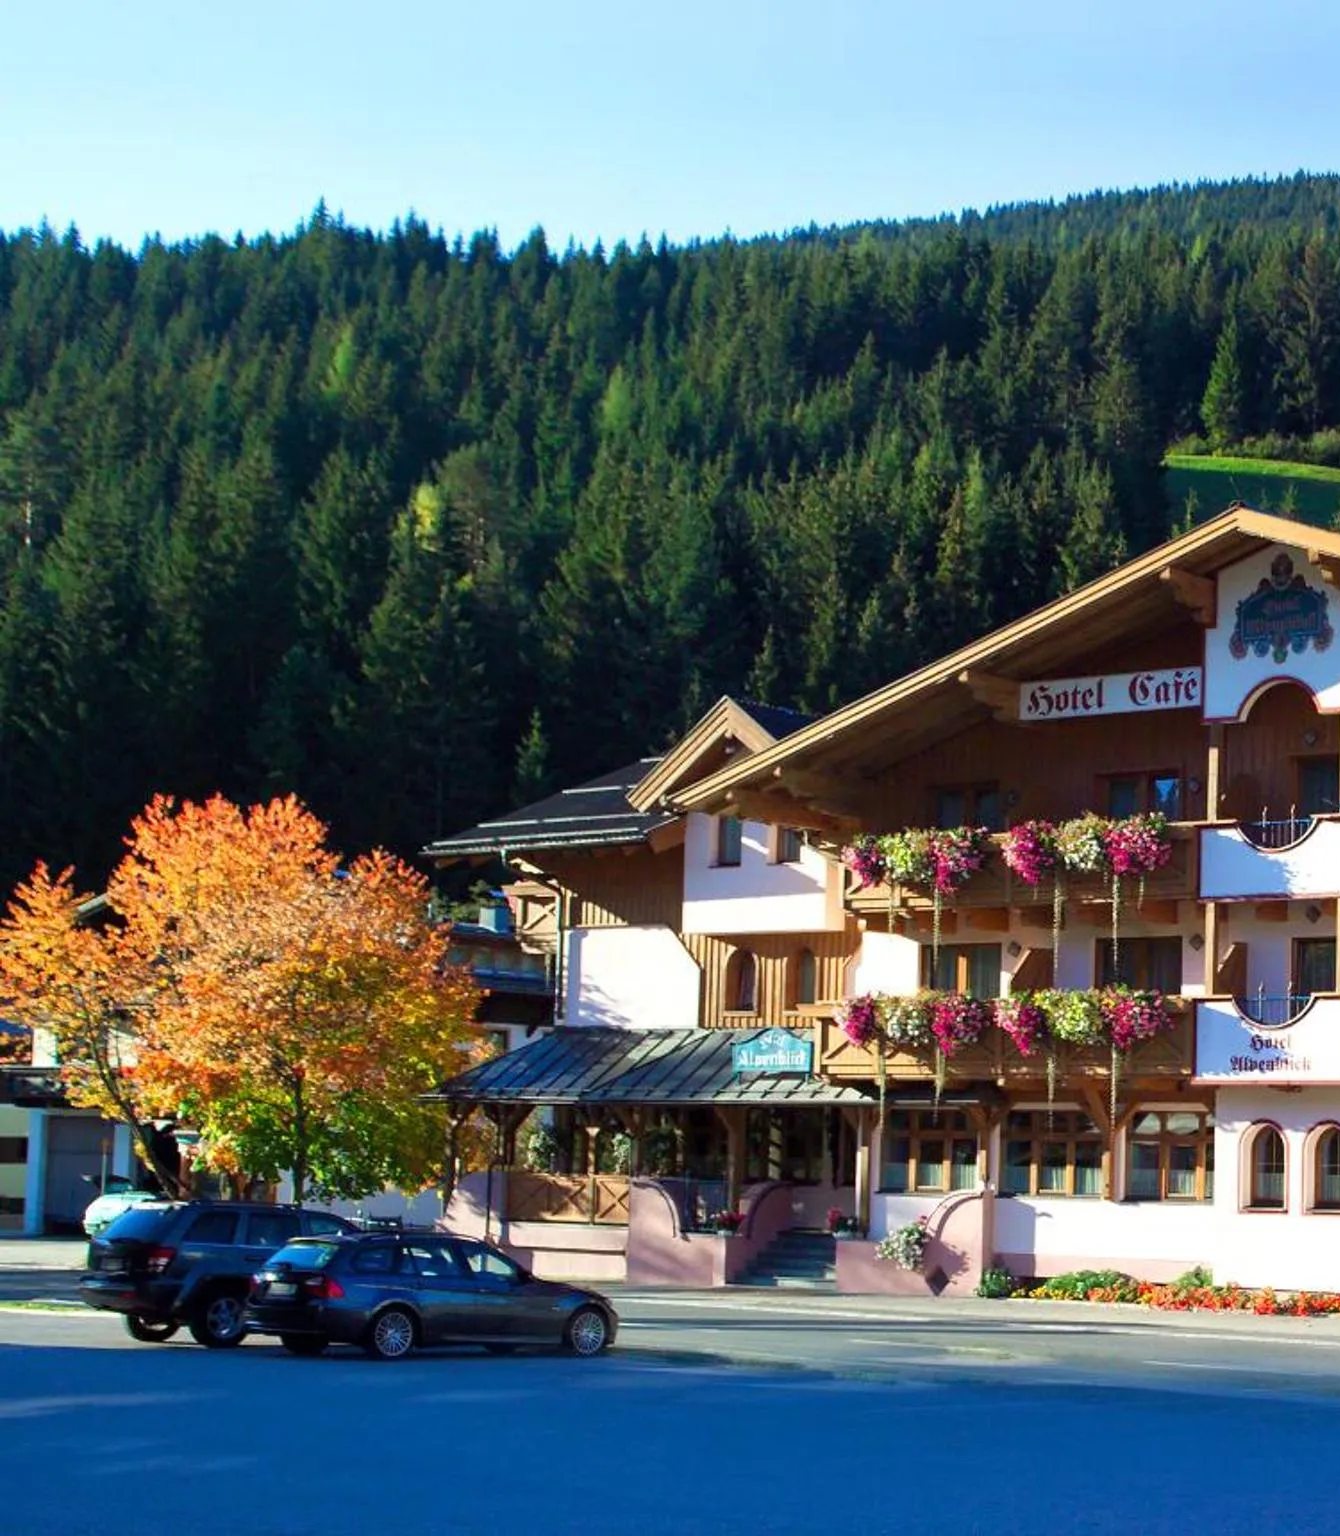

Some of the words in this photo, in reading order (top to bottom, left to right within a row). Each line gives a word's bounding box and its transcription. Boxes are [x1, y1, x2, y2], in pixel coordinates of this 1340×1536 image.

[1027, 678, 1104, 716] Hotel
[1129, 671, 1198, 706] Café
[1250, 1033, 1292, 1053] Hotel
